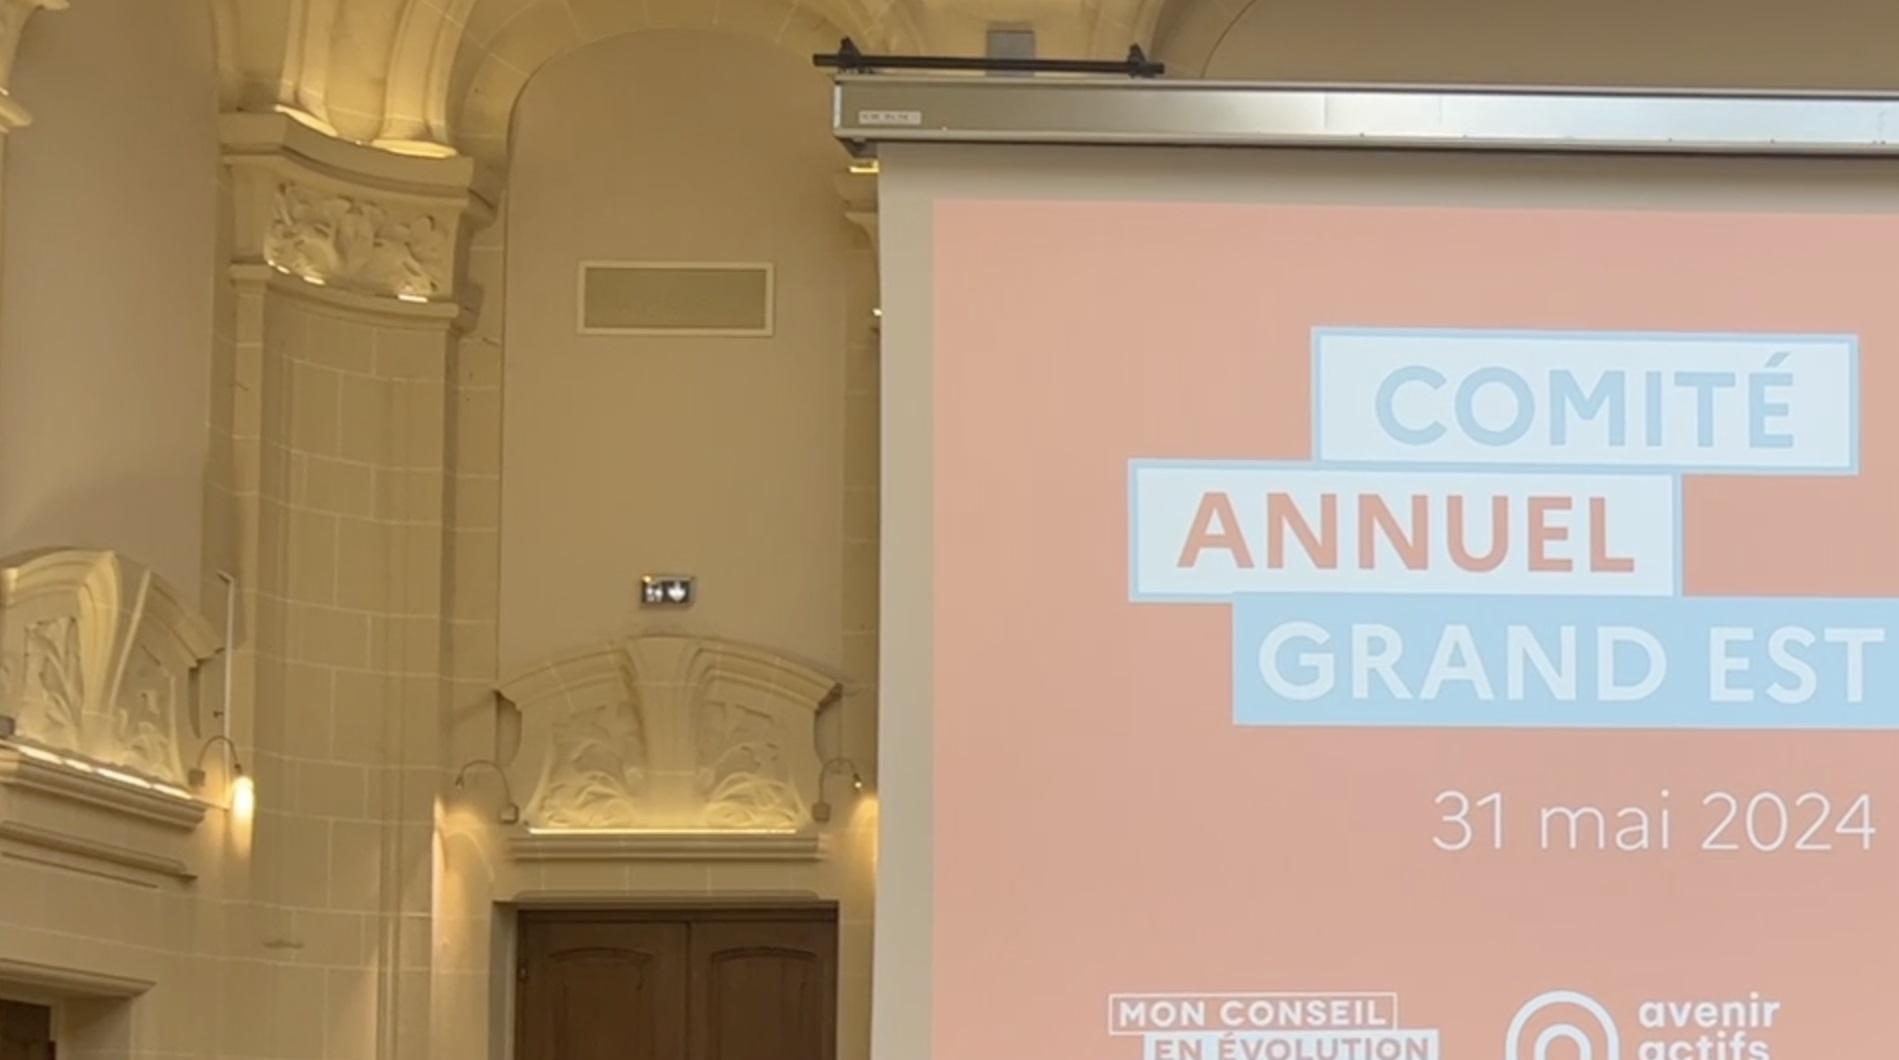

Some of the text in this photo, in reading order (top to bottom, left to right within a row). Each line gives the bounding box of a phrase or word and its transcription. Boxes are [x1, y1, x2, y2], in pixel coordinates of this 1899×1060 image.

[1375, 352, 1795, 449] COMITÉ
[1176, 491, 1635, 573] ANNUEL
[1258, 621, 1886, 704] GRAND EST
[1433, 789, 1877, 852] 31 mai 2024
[1119, 1000, 1387, 1027] MON CONSEIL
[1638, 991, 1781, 1028] avenir
